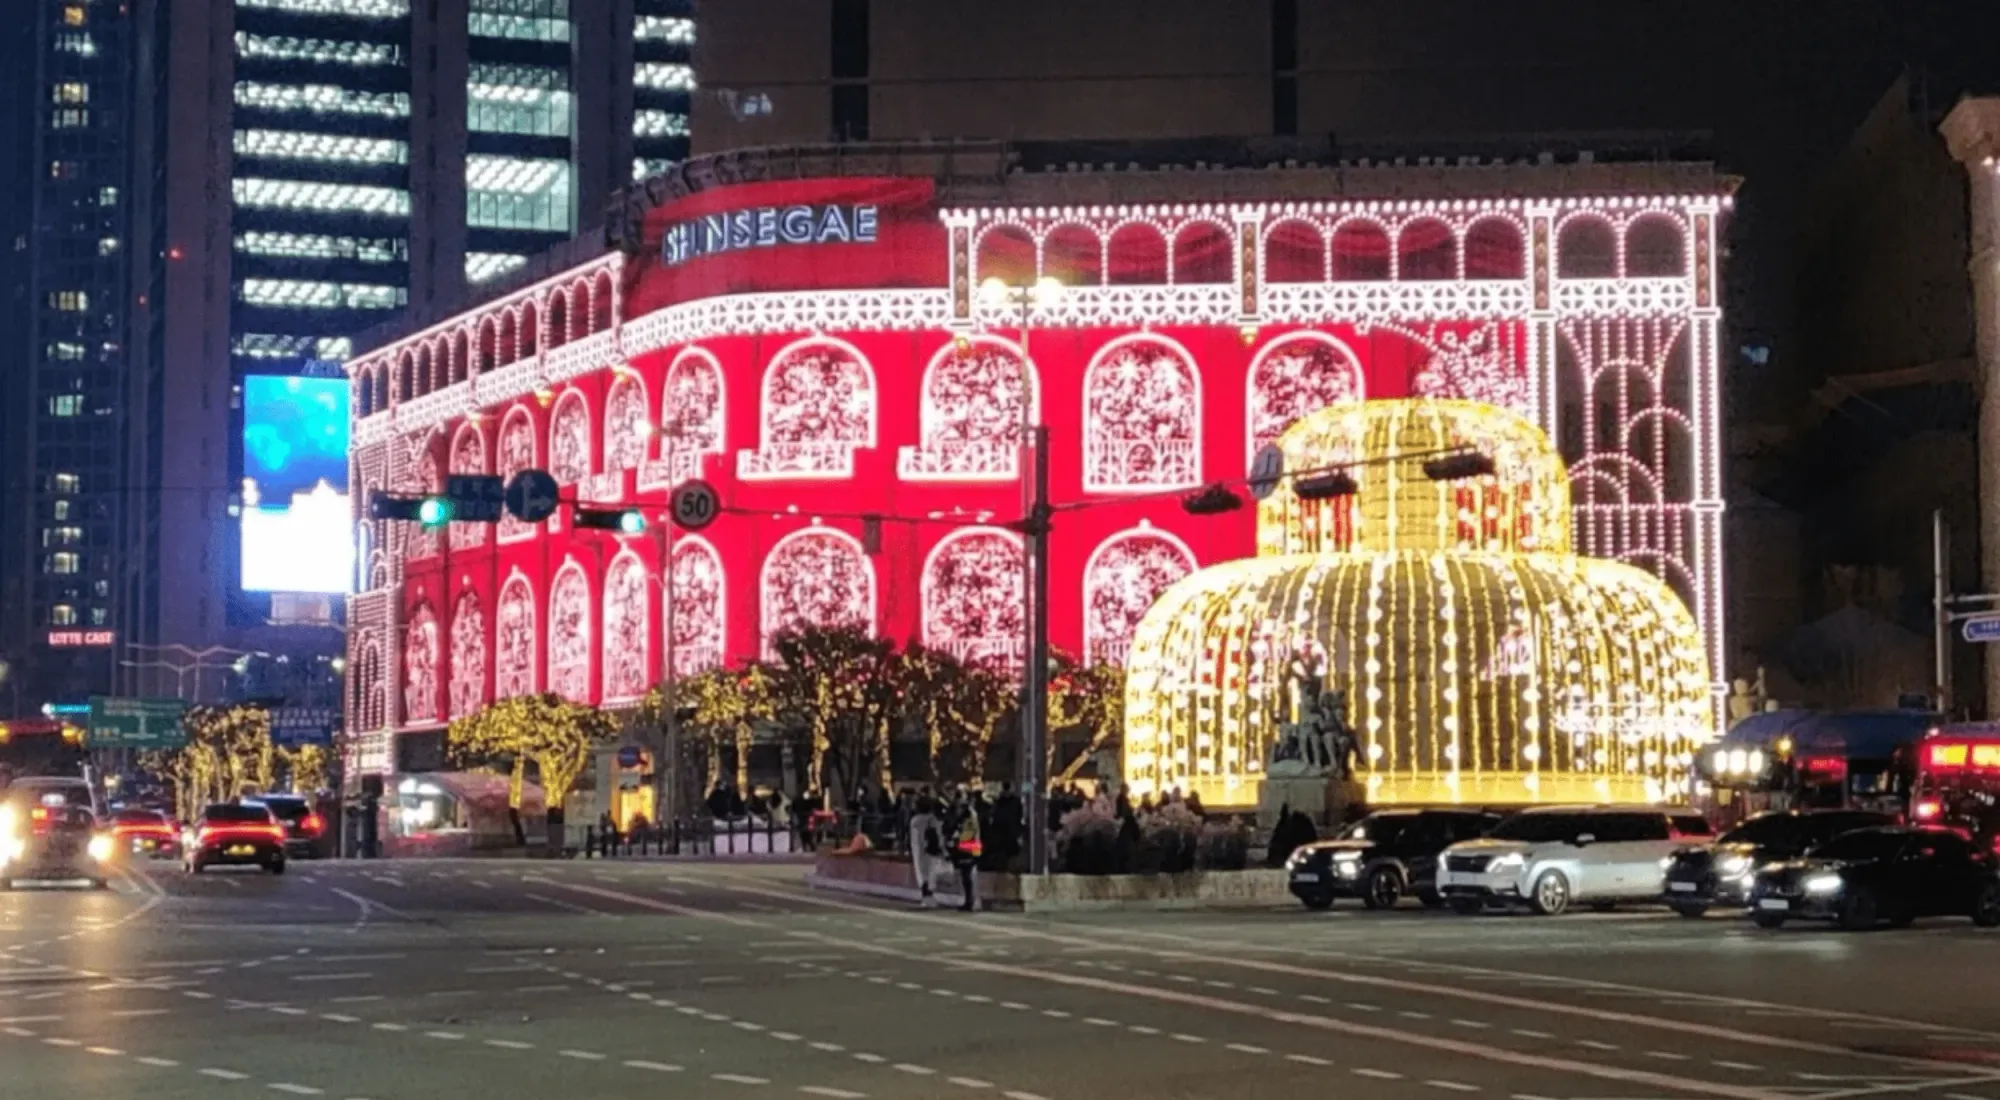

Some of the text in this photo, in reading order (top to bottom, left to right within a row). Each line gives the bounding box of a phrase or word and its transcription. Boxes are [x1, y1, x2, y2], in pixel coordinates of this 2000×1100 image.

[664, 203, 878, 265] SHINSEGAE
[681, 491, 709, 518] 50
[48, 631, 82, 645] LOTTE
